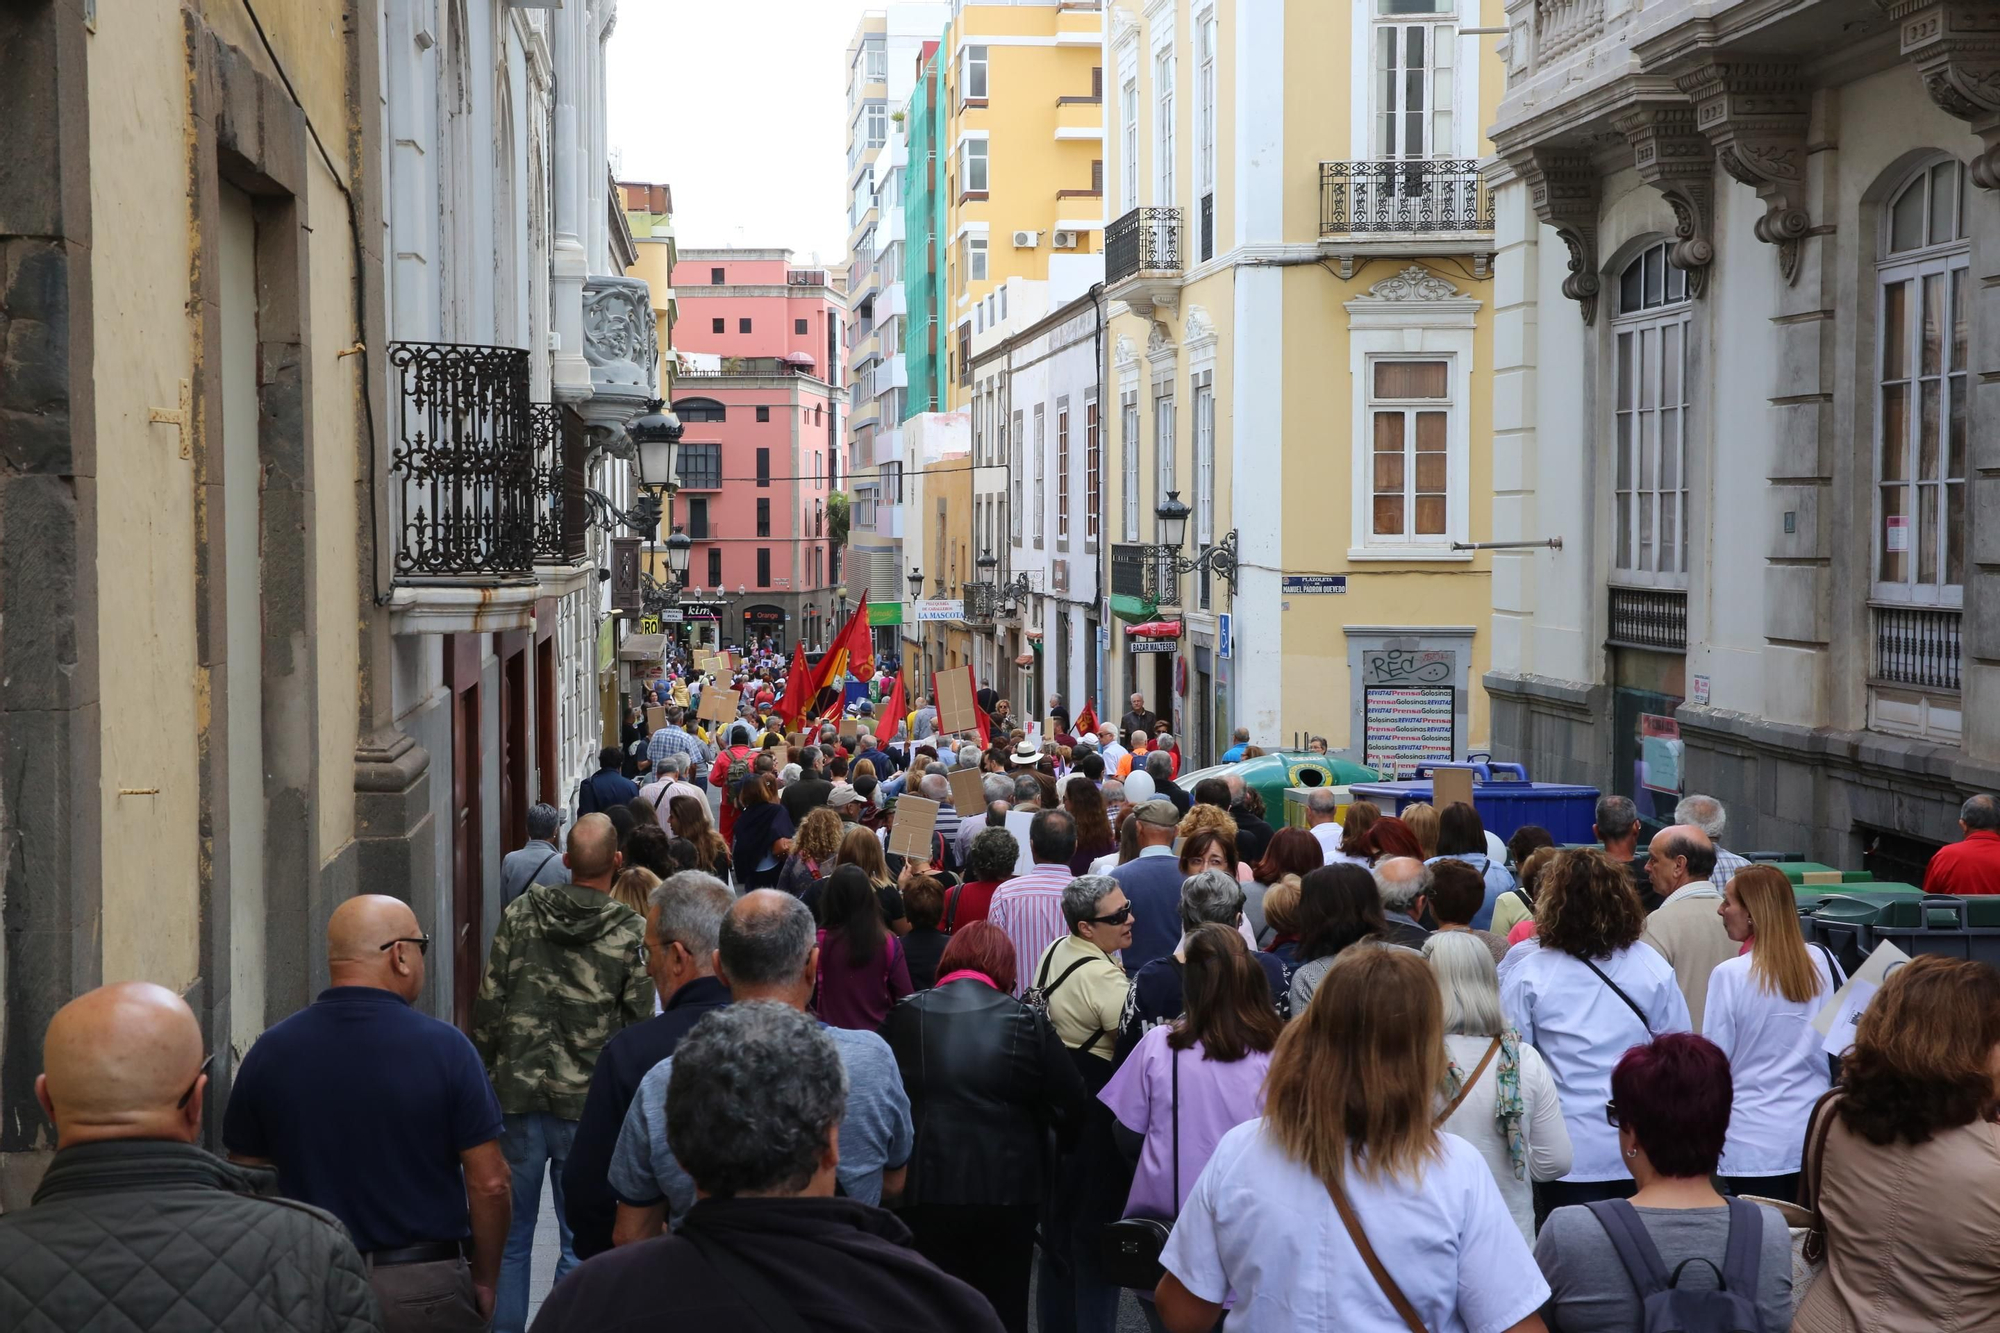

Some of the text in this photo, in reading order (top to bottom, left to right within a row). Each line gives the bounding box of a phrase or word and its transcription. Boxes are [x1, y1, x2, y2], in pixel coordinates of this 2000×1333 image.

[1283, 585, 1302, 593] MANUEL
[1323, 585, 1345, 593] QUEVEDO
[688, 605, 710, 616] kim
[757, 611, 779, 619] Orange
[1132, 642, 1176, 652] BAZAR MALTESES
[1421, 689, 1452, 697] Golosinas
